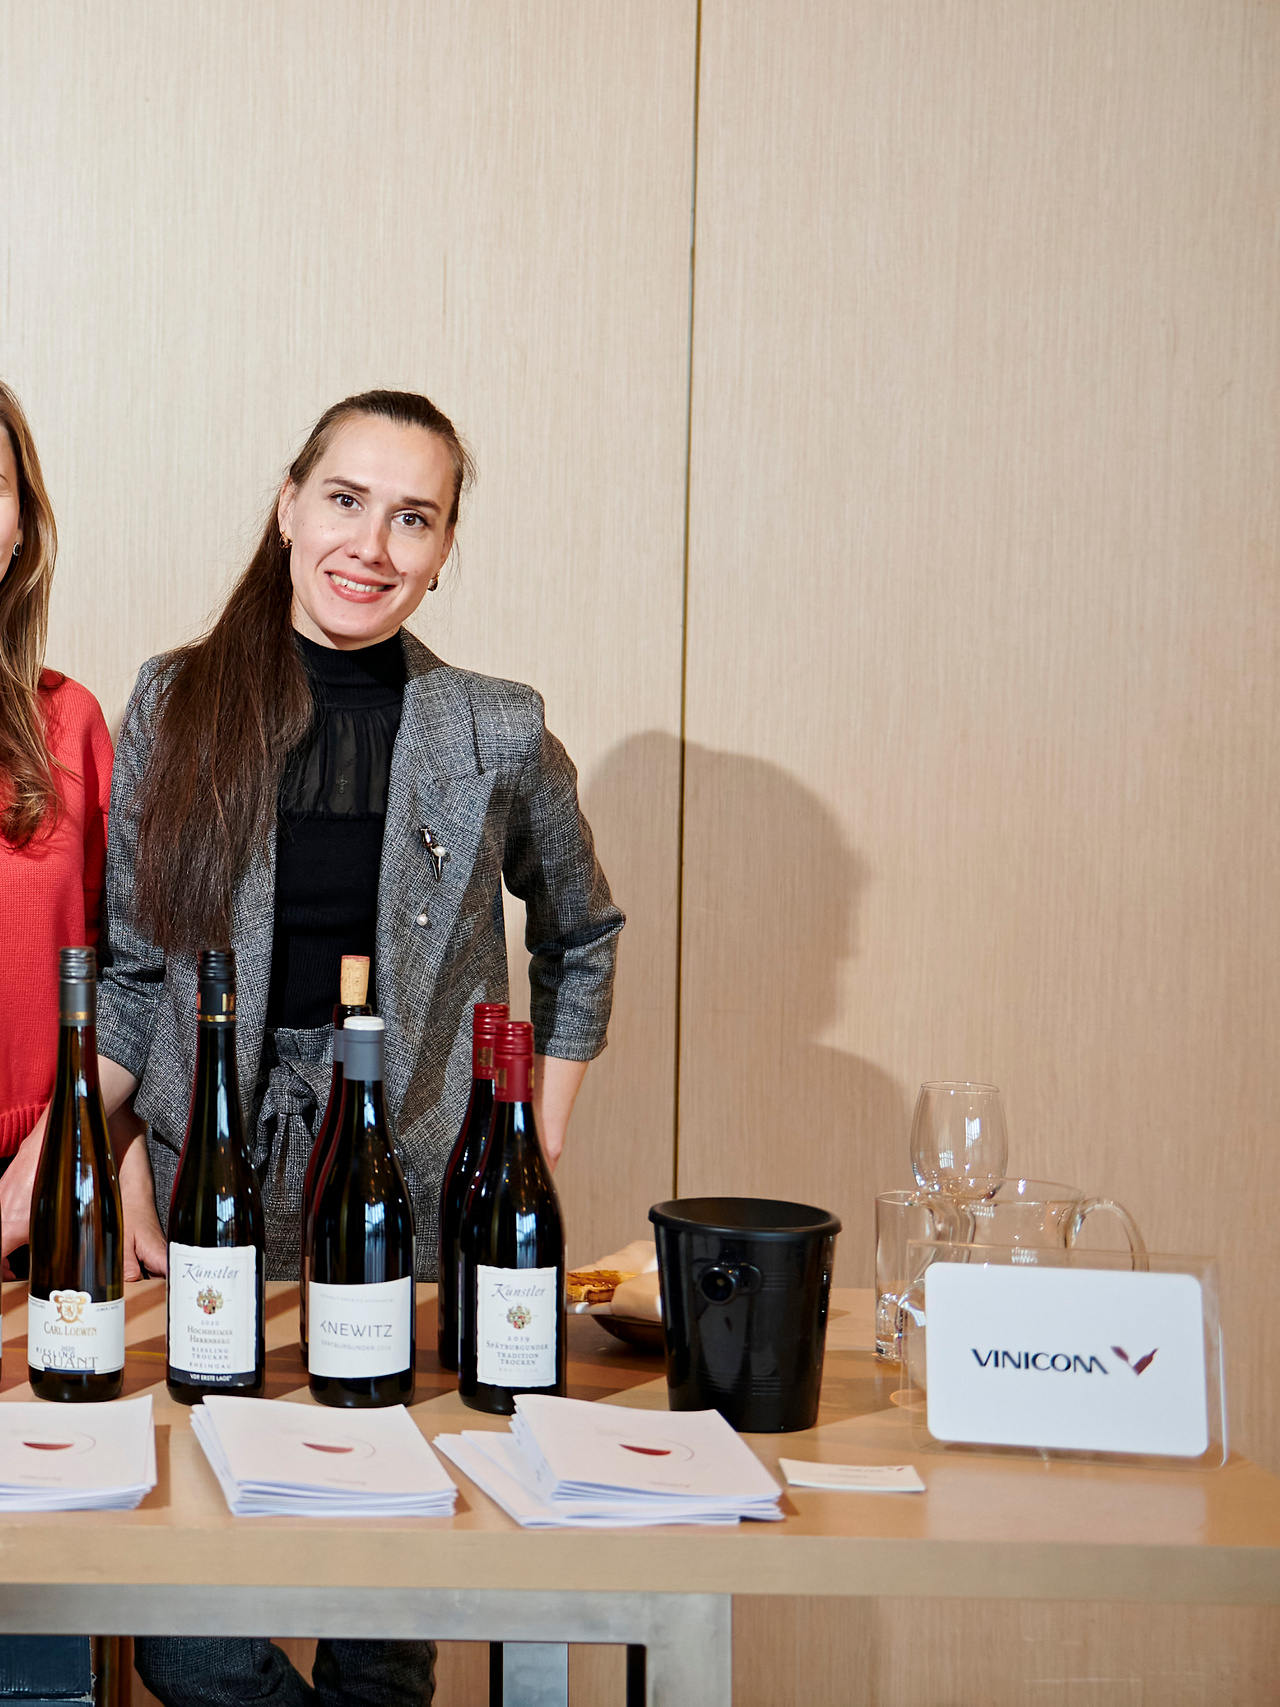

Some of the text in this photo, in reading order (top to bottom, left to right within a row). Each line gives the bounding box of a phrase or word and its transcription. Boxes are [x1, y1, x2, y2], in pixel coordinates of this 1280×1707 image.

[491, 1283, 547, 1302] Künstler
[43, 1320, 64, 1336] CARL
[41, 1353, 99, 1369] QUANT
[497, 1351, 539, 1359] TRADITION
[970, 1347, 1110, 1375] VINICOM
